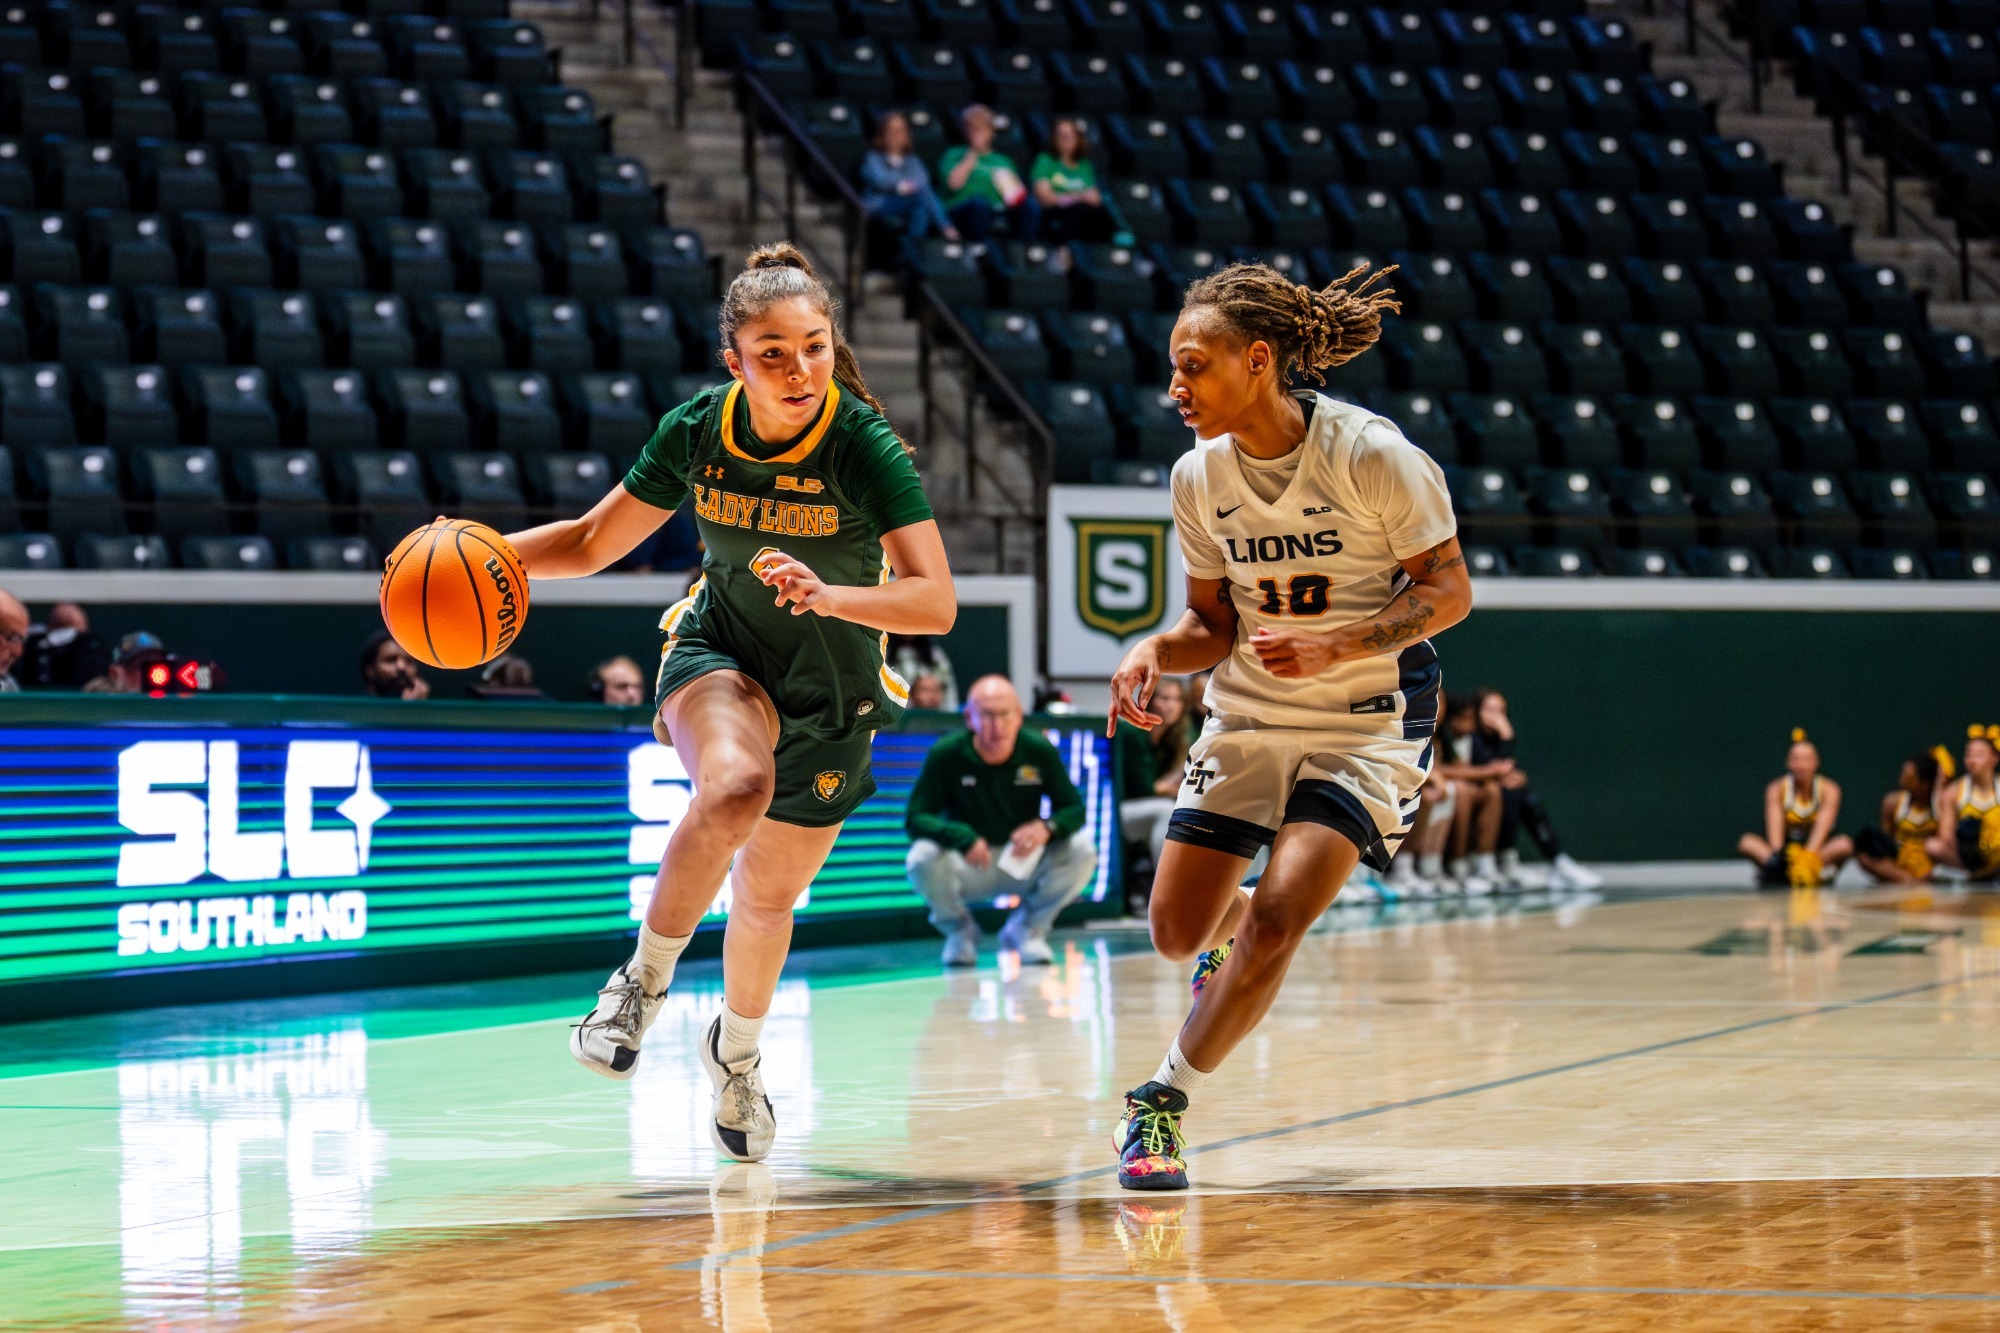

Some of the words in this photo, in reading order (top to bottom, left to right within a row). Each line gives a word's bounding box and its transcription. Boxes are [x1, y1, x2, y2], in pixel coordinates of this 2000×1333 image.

[694, 484, 759, 529] LADY
[758, 499, 839, 537] LIONS
[775, 475, 824, 494] SLC
[1302, 506, 1333, 517] SLC
[1226, 529, 1344, 564] LIONS
[1095, 541, 1148, 610] S
[1256, 572, 1334, 618] 10
[484, 555, 518, 656] Wilson
[117, 740, 375, 887] SLC
[117, 890, 368, 957] SOUTHLAND
